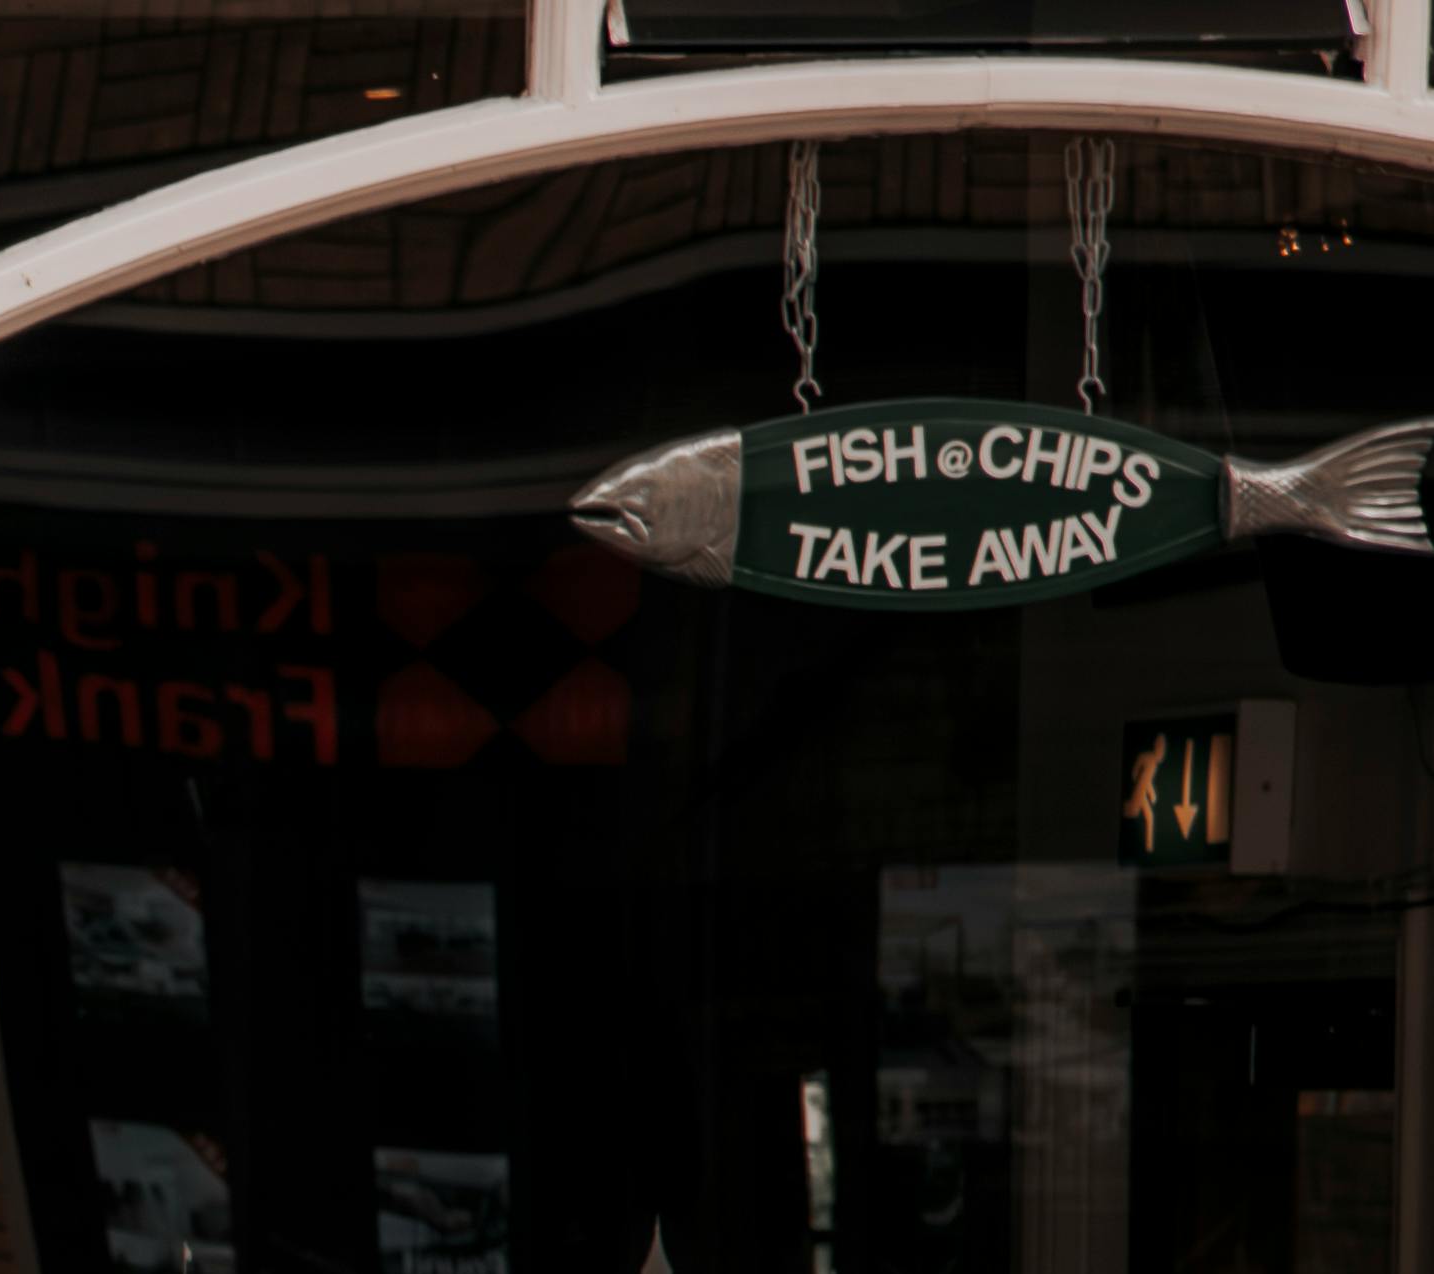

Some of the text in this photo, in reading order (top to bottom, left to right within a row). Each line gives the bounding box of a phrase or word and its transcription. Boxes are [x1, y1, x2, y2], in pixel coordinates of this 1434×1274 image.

[792, 425, 927, 495] FISH
[978, 426, 1160, 508] CHIPS
[789, 504, 1122, 590] TAKE AWAY
